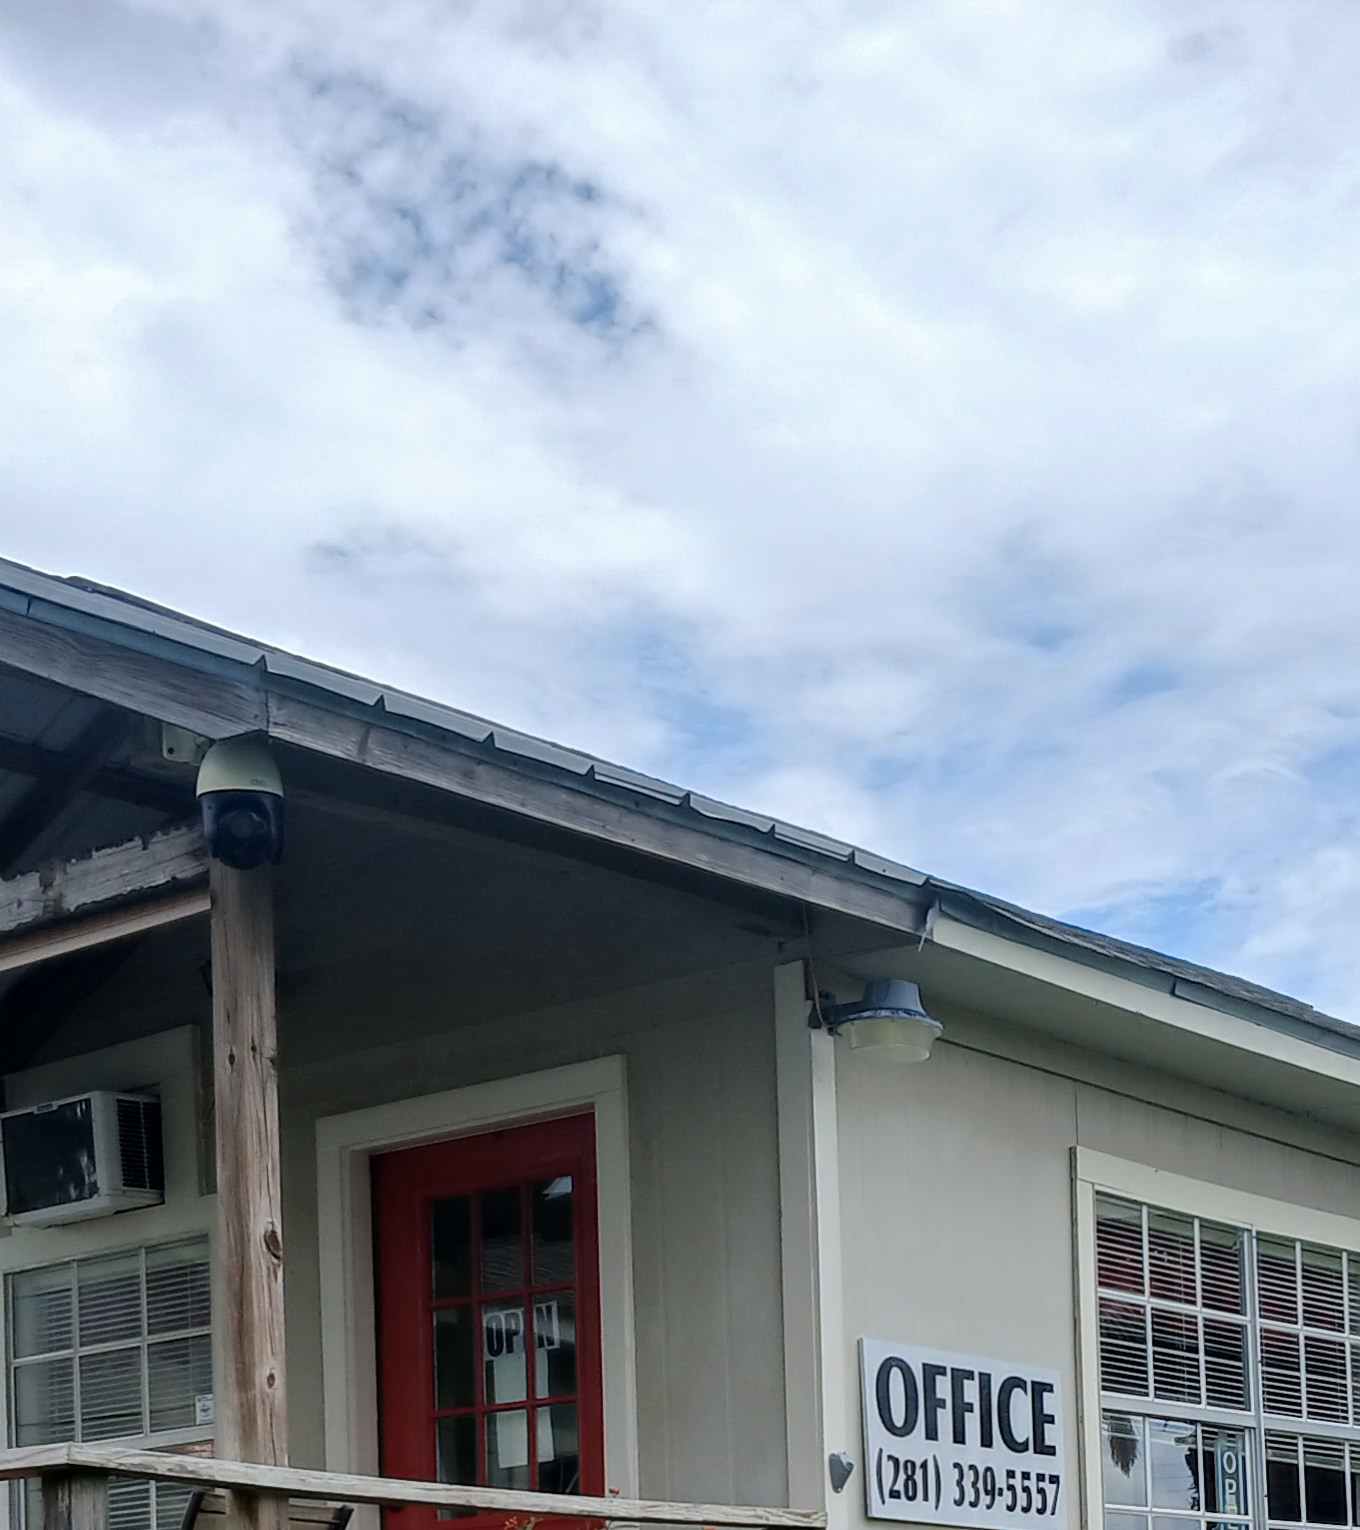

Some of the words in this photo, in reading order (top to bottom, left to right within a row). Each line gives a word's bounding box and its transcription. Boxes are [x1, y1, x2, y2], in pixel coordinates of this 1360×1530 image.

[485, 1303, 556, 1358] OPN
[875, 1356, 1057, 1457] OFFICE
[876, 1448, 942, 1511] (281)
[952, 1461, 1061, 1516] 339-5557
